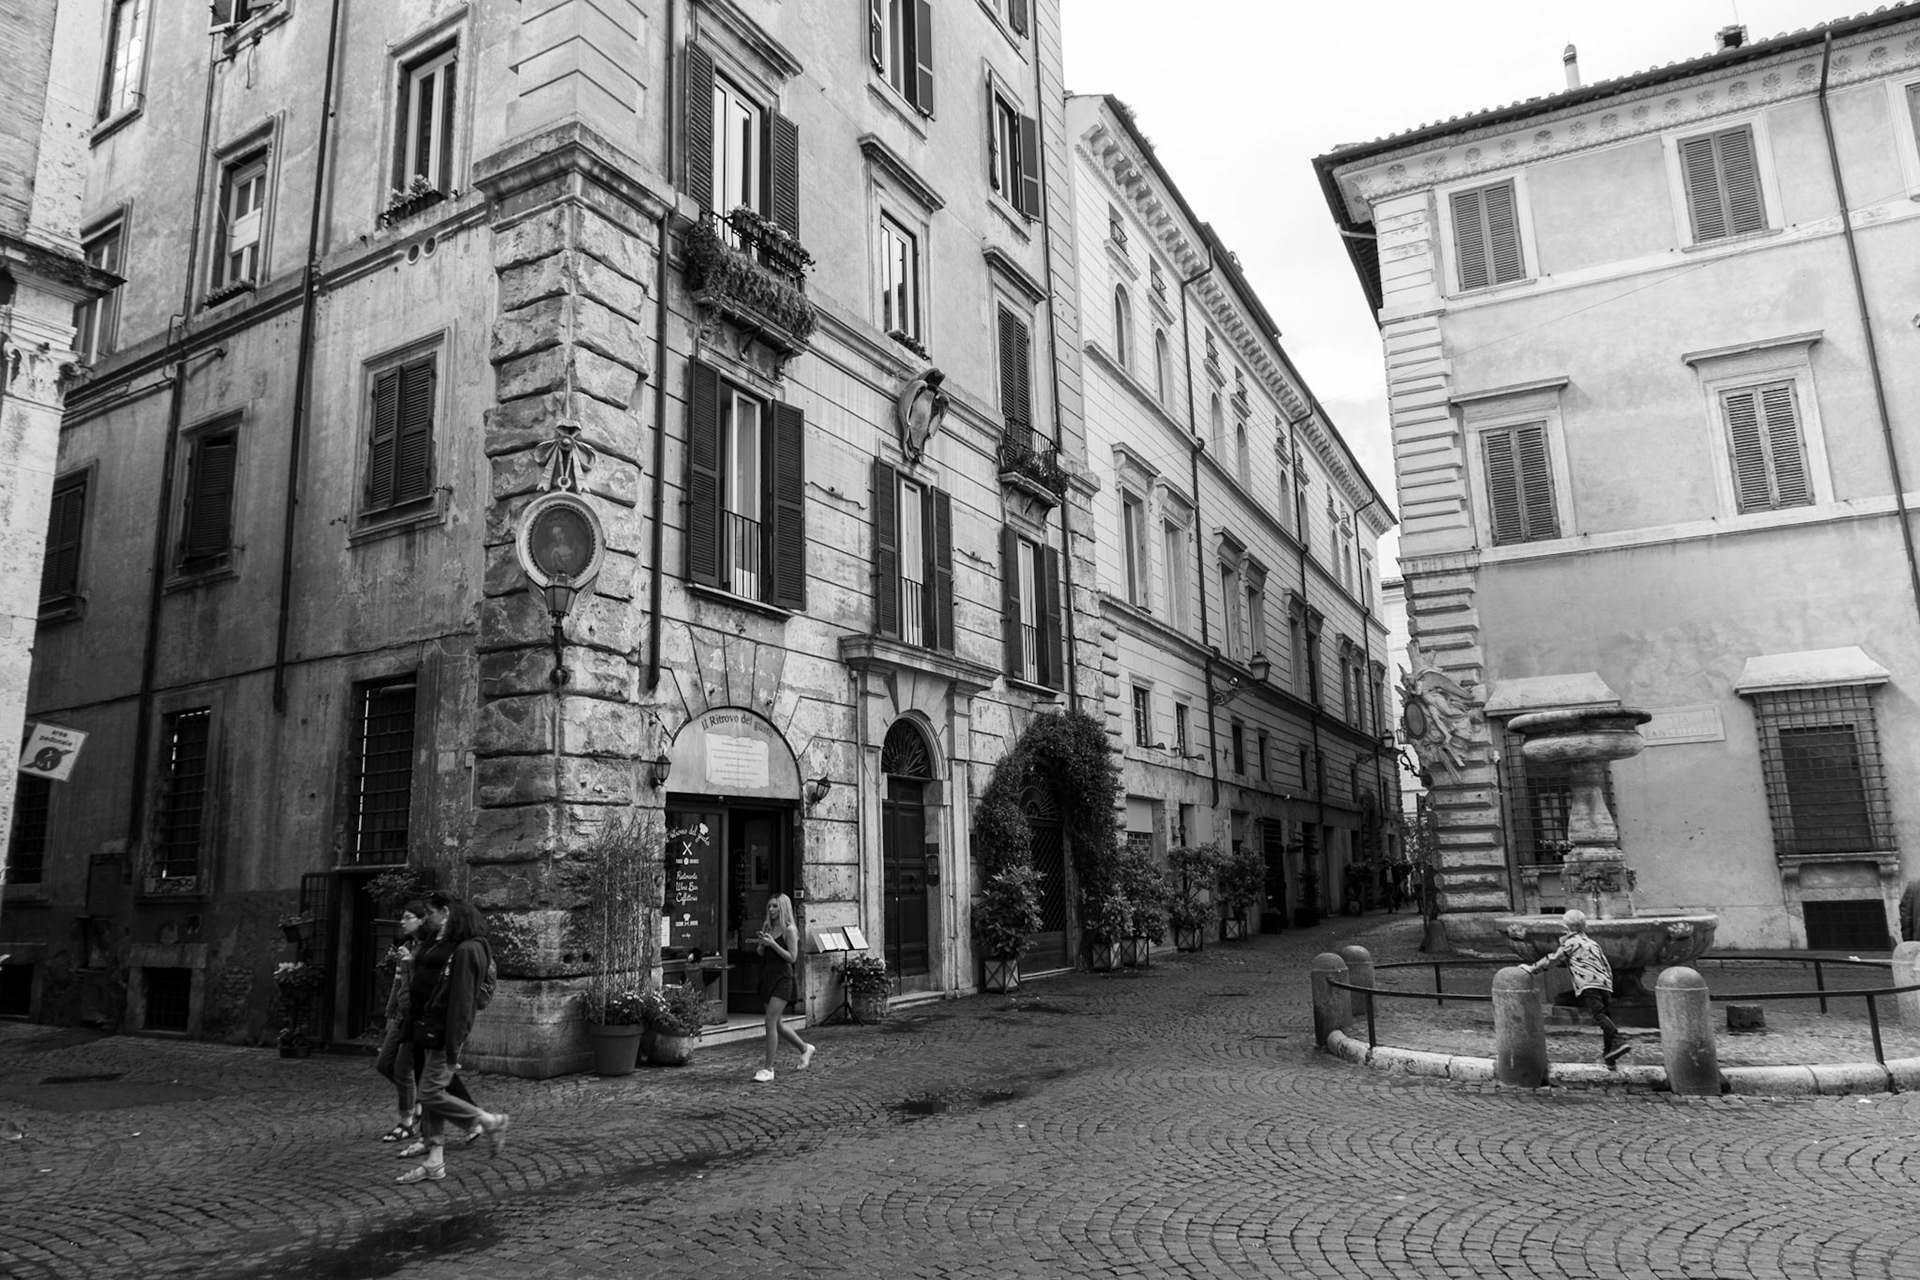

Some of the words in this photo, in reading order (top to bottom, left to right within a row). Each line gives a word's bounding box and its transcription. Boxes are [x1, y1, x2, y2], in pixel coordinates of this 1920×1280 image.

[709, 714, 739, 726] Ritrovo
[741, 713, 752, 726] del
[753, 721, 773, 739] gusto
[39, 735, 72, 746] pedonale
